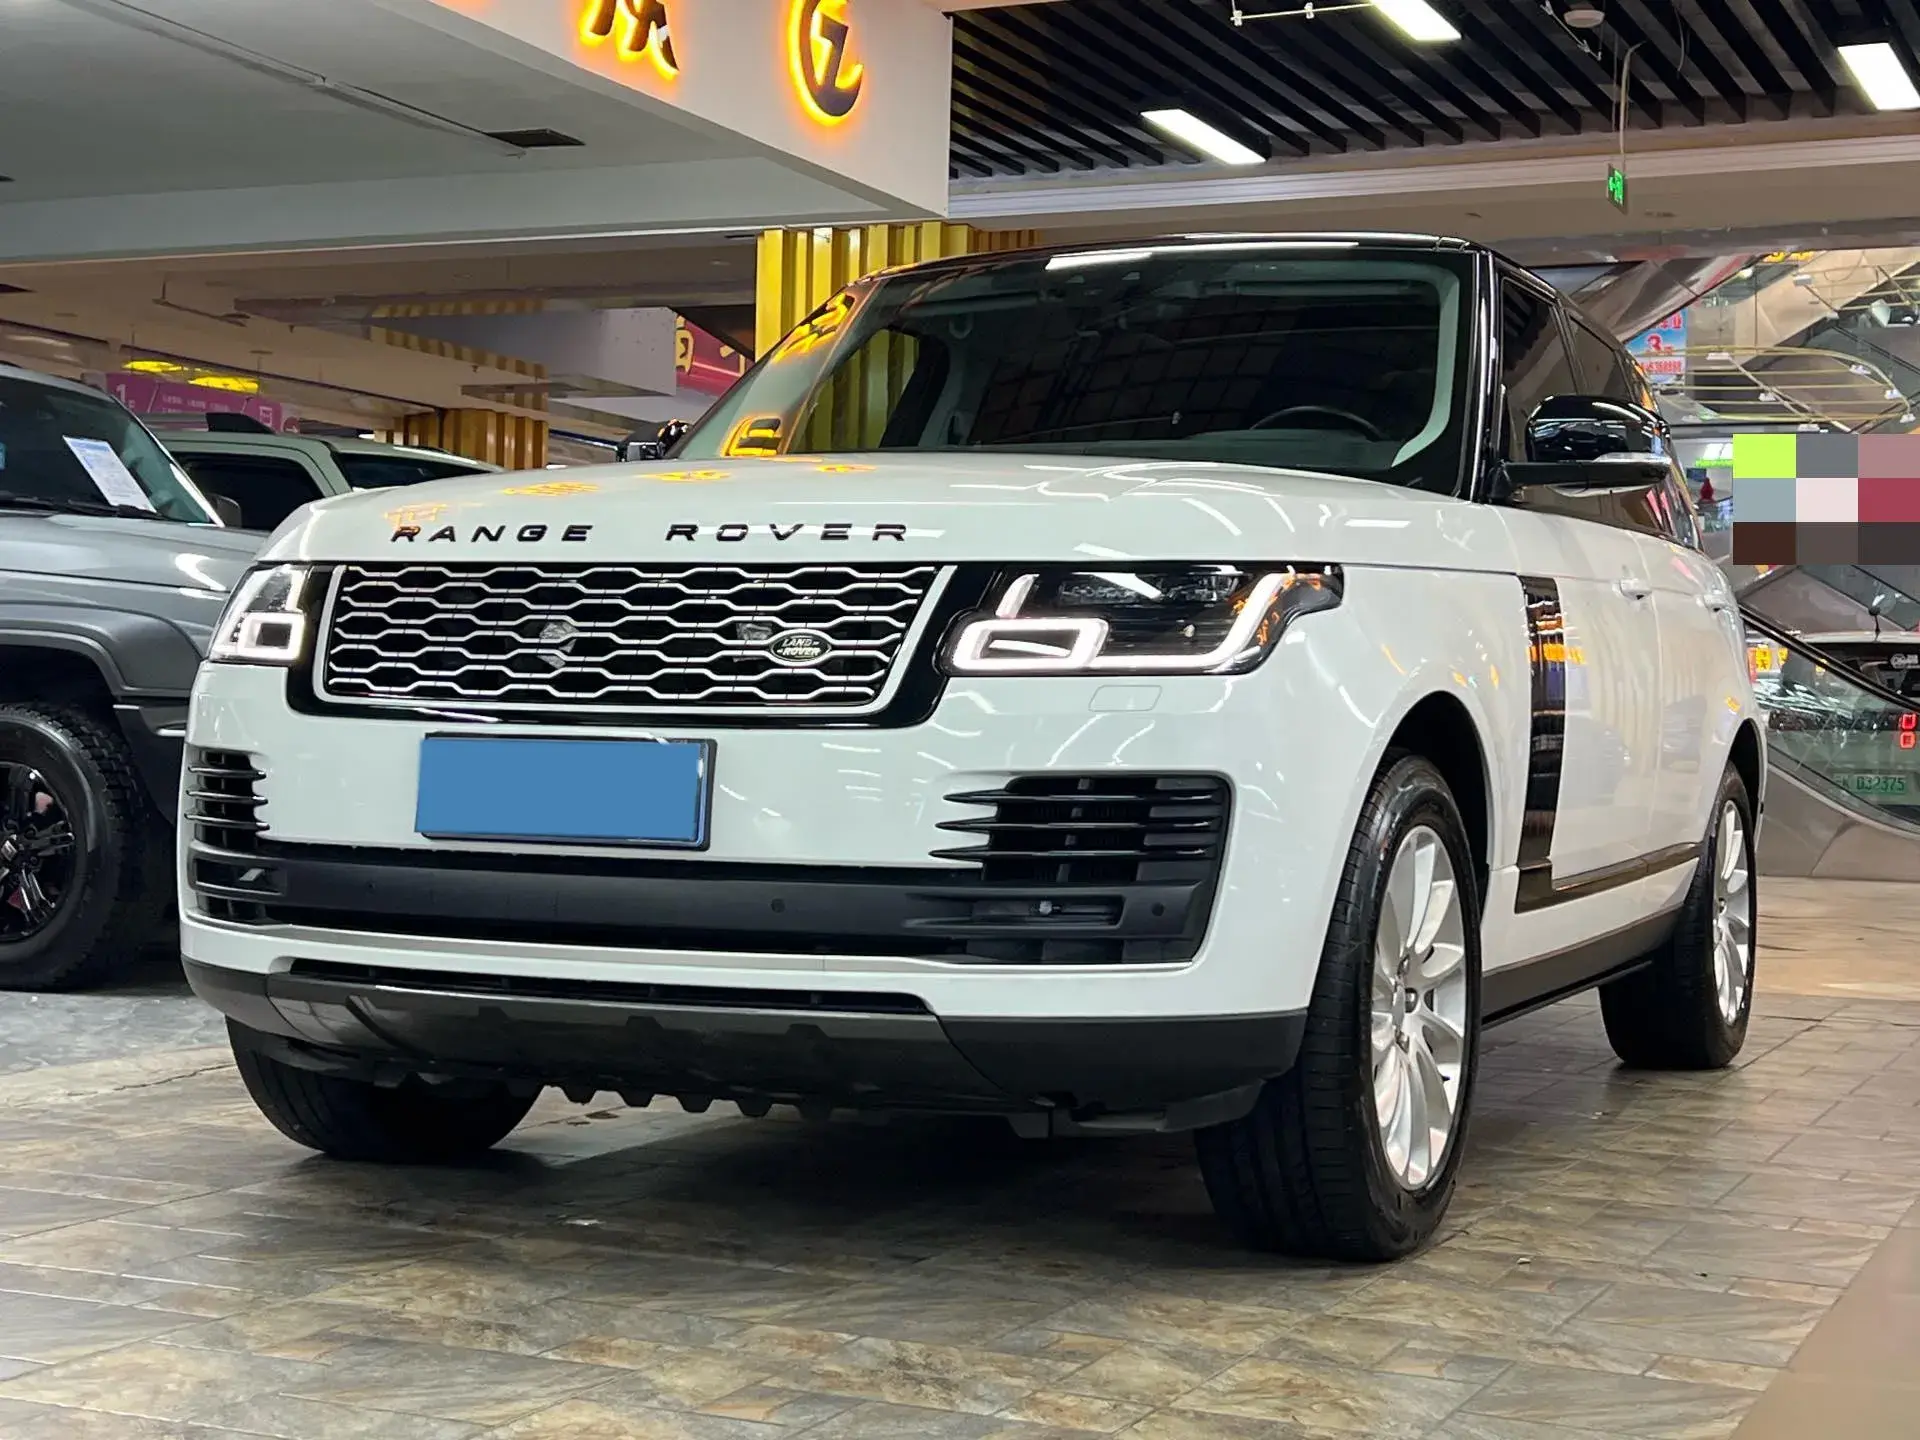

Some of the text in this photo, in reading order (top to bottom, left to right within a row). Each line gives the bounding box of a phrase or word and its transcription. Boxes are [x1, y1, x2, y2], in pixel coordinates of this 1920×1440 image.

[391, 523, 908, 543] RANGE ROVER
[782, 638, 813, 647] LAND
[783, 647, 821, 656] ROVER
